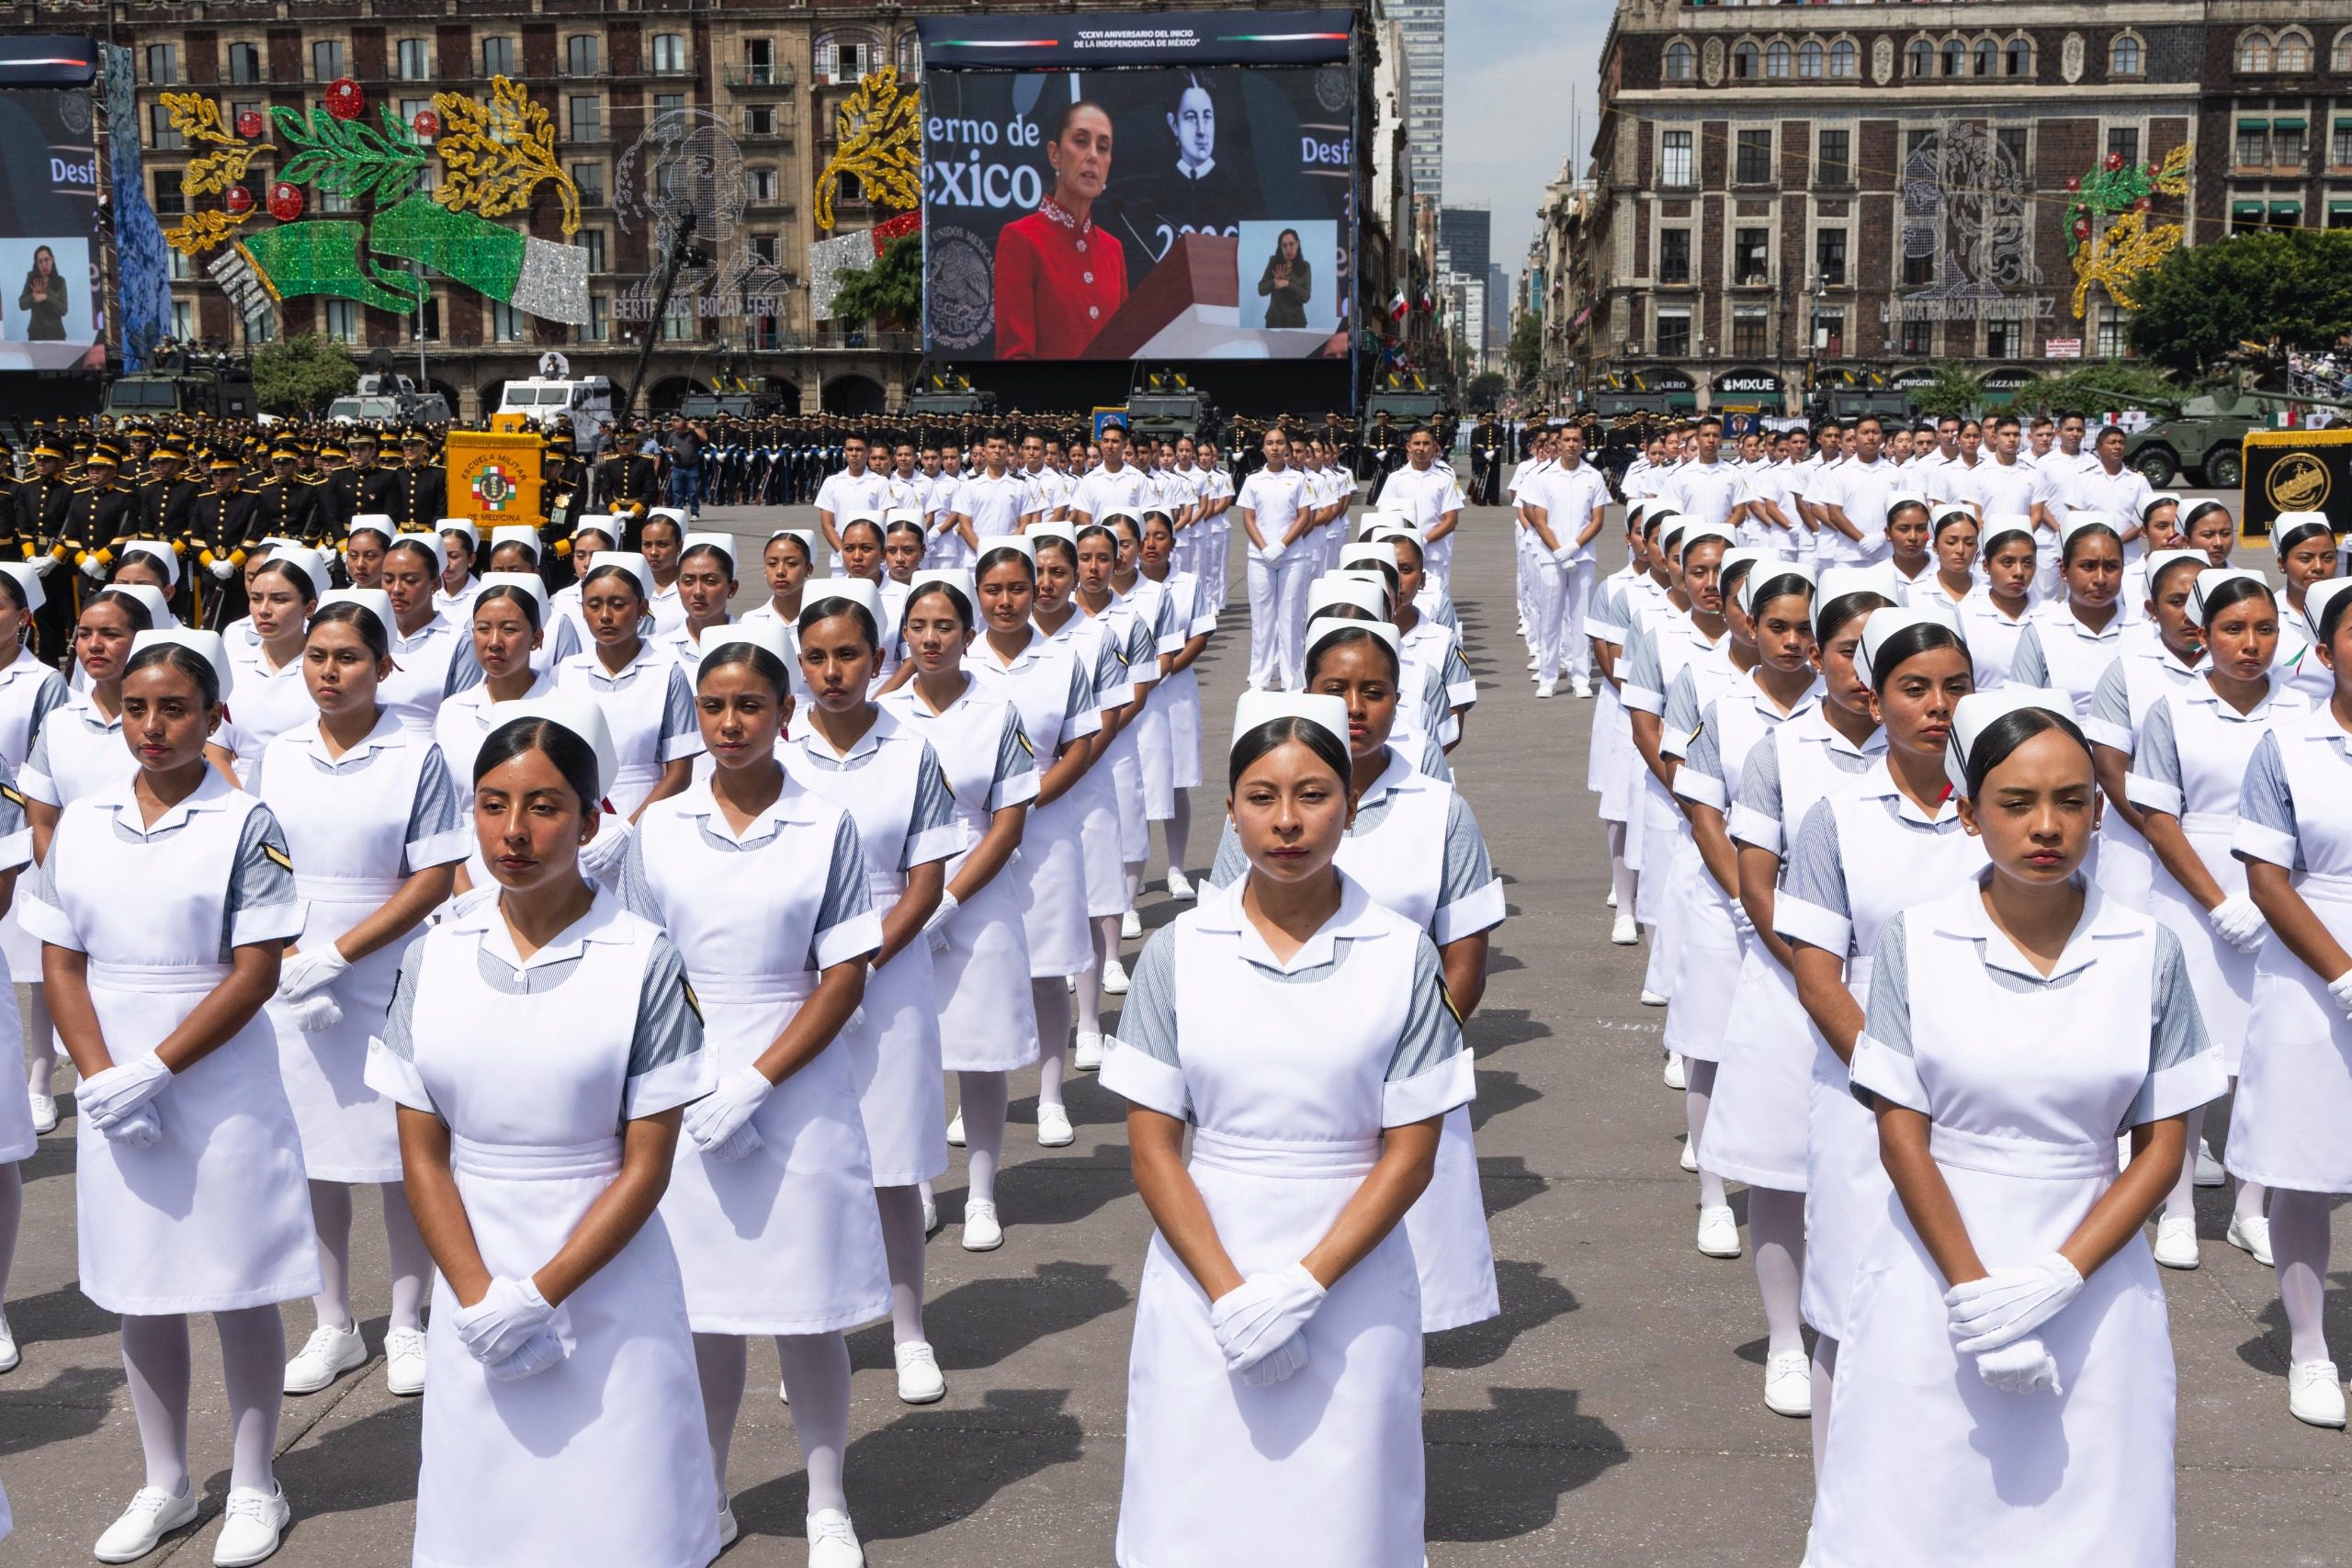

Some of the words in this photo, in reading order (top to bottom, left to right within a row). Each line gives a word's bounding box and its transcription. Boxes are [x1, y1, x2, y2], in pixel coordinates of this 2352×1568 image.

[1073, 39, 1084, 48] DE
[1084, 39, 1095, 48] LA
[1095, 39, 1156, 48] INDEPENDENCIA
[1156, 39, 1167, 47] DE
[1103, 29, 1154, 38] ANIVERSARIO
[1154, 29, 1170, 38] DEL
[1170, 29, 1194, 38] INICIO
[927, 117, 999, 145] erno
[1007, 113, 1040, 147] de
[1301, 137, 1350, 164] Desf
[932, 226, 964, 242] UNIDOS
[966, 231, 995, 273] MEXICA
[612, 297, 692, 320] GERTRDIS
[1732, 378, 1775, 390] MIXUE
[461, 454, 495, 479] ESCUELA
[497, 454, 527, 480] MILITAR
[481, 513, 521, 522] MEDICINA
